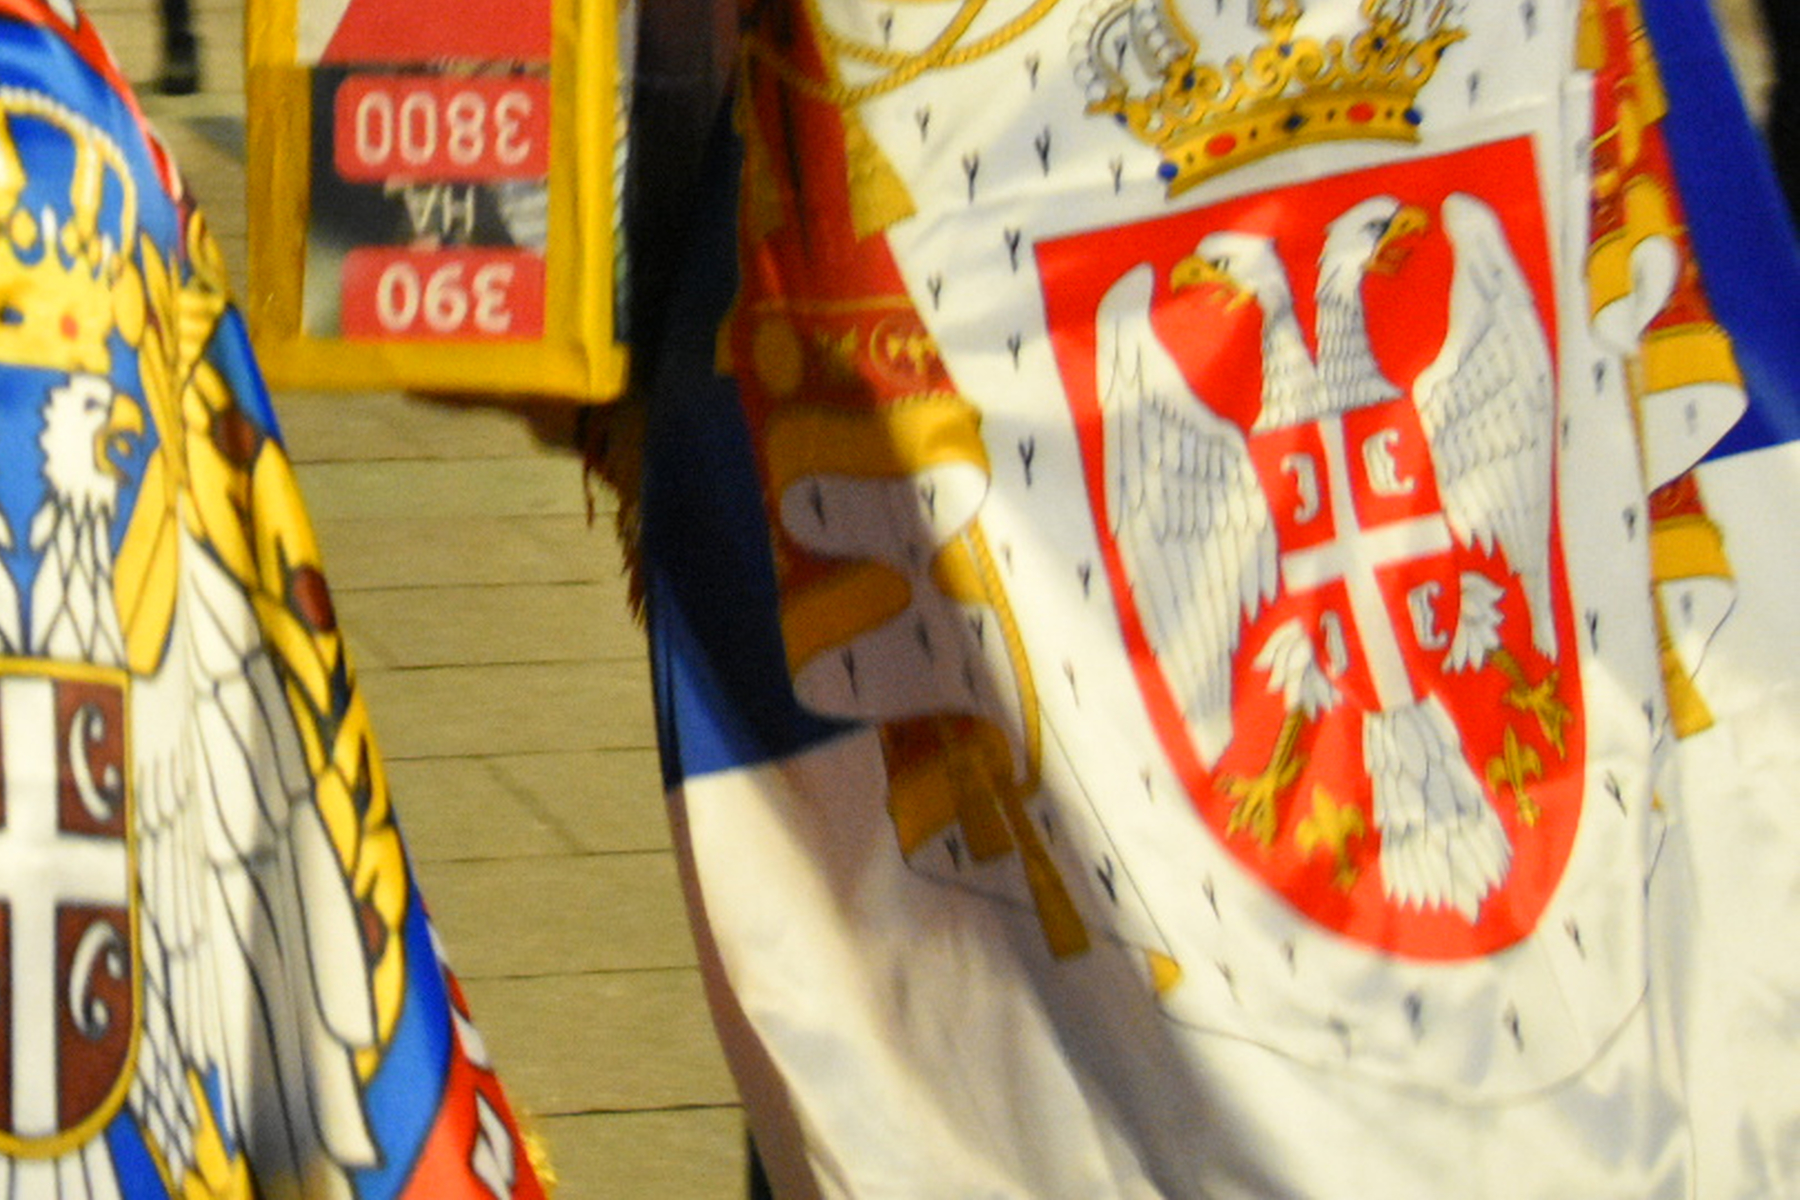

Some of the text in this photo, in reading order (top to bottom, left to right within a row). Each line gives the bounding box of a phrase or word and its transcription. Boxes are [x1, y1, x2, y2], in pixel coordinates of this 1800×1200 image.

[355, 91, 532, 166] 3800
[403, 183, 475, 237] НА
[376, 261, 515, 332] 390
